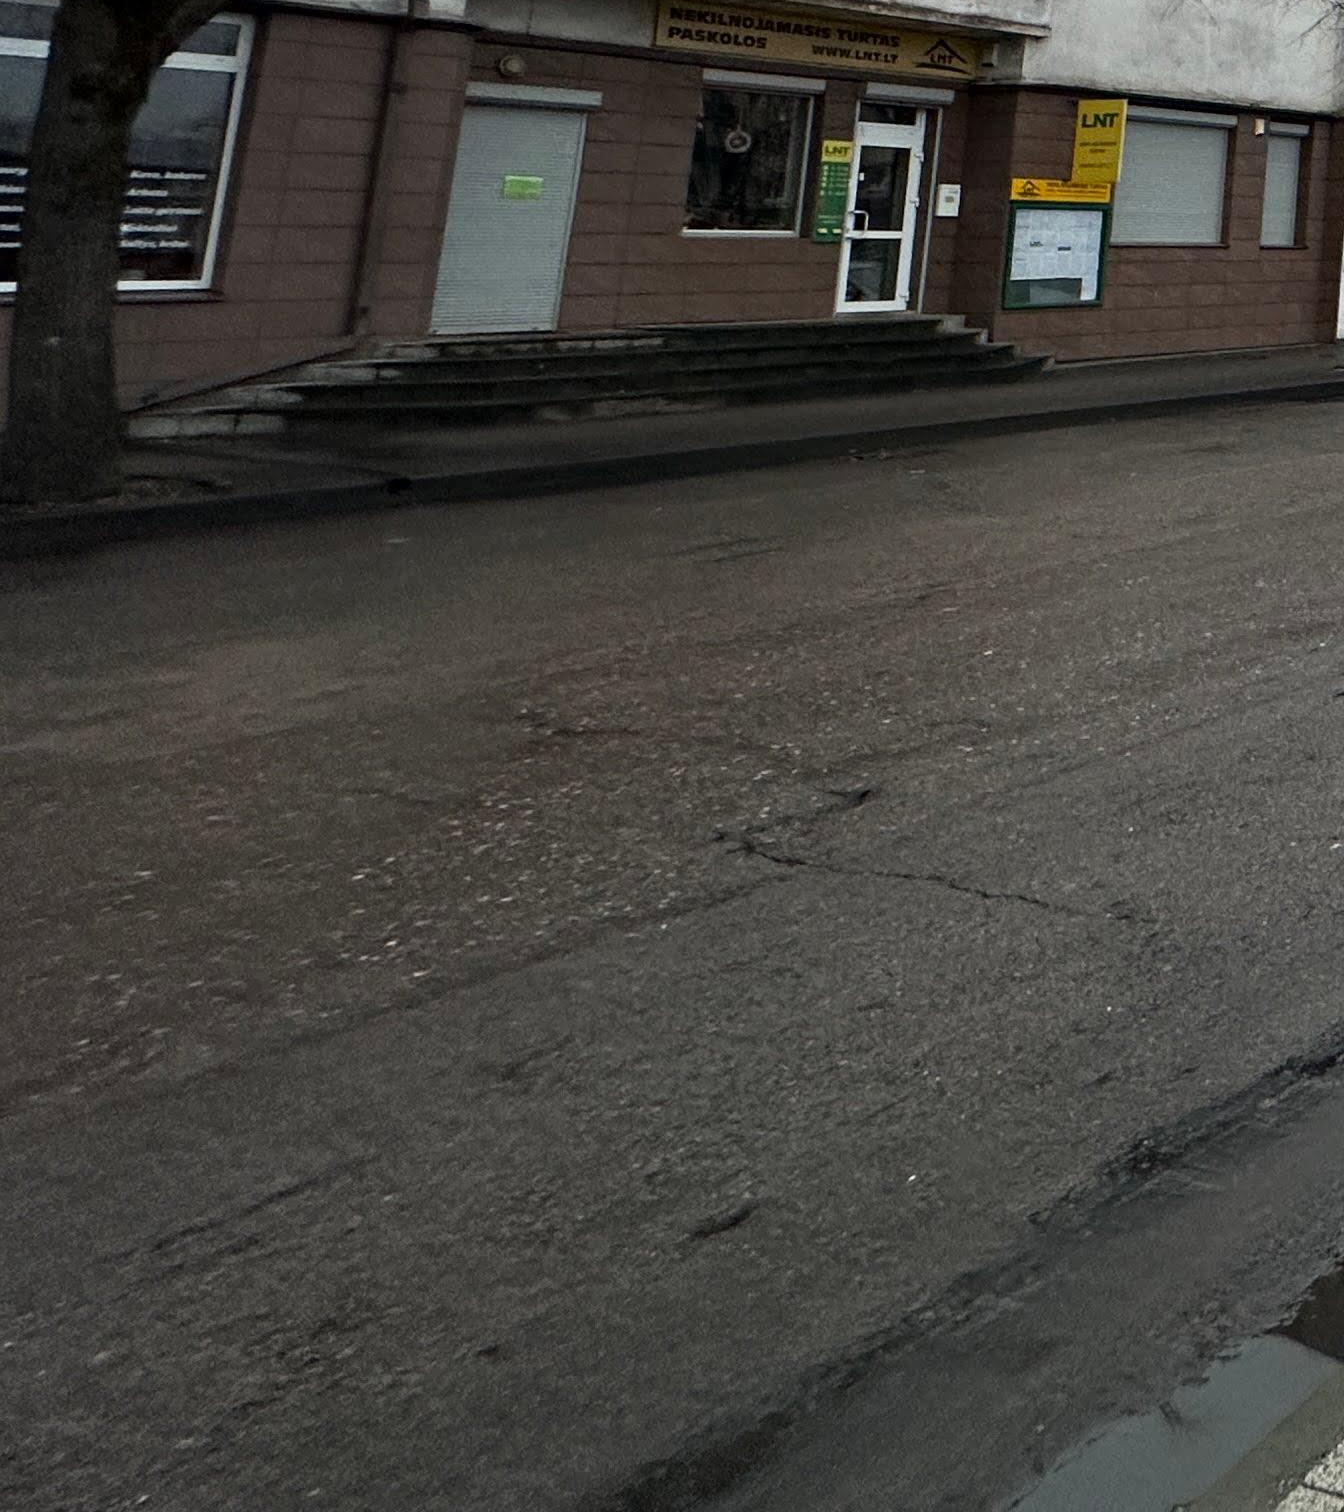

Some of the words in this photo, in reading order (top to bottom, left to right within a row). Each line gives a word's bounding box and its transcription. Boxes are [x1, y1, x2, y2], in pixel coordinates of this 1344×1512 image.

[669, 7, 834, 39] NEKILNOJAMASIS
[836, 28, 900, 48] TURTAS
[668, 26, 767, 50] PASKOLOS
[1081, 112, 1120, 128] LNT
[824, 145, 851, 157] LNT
